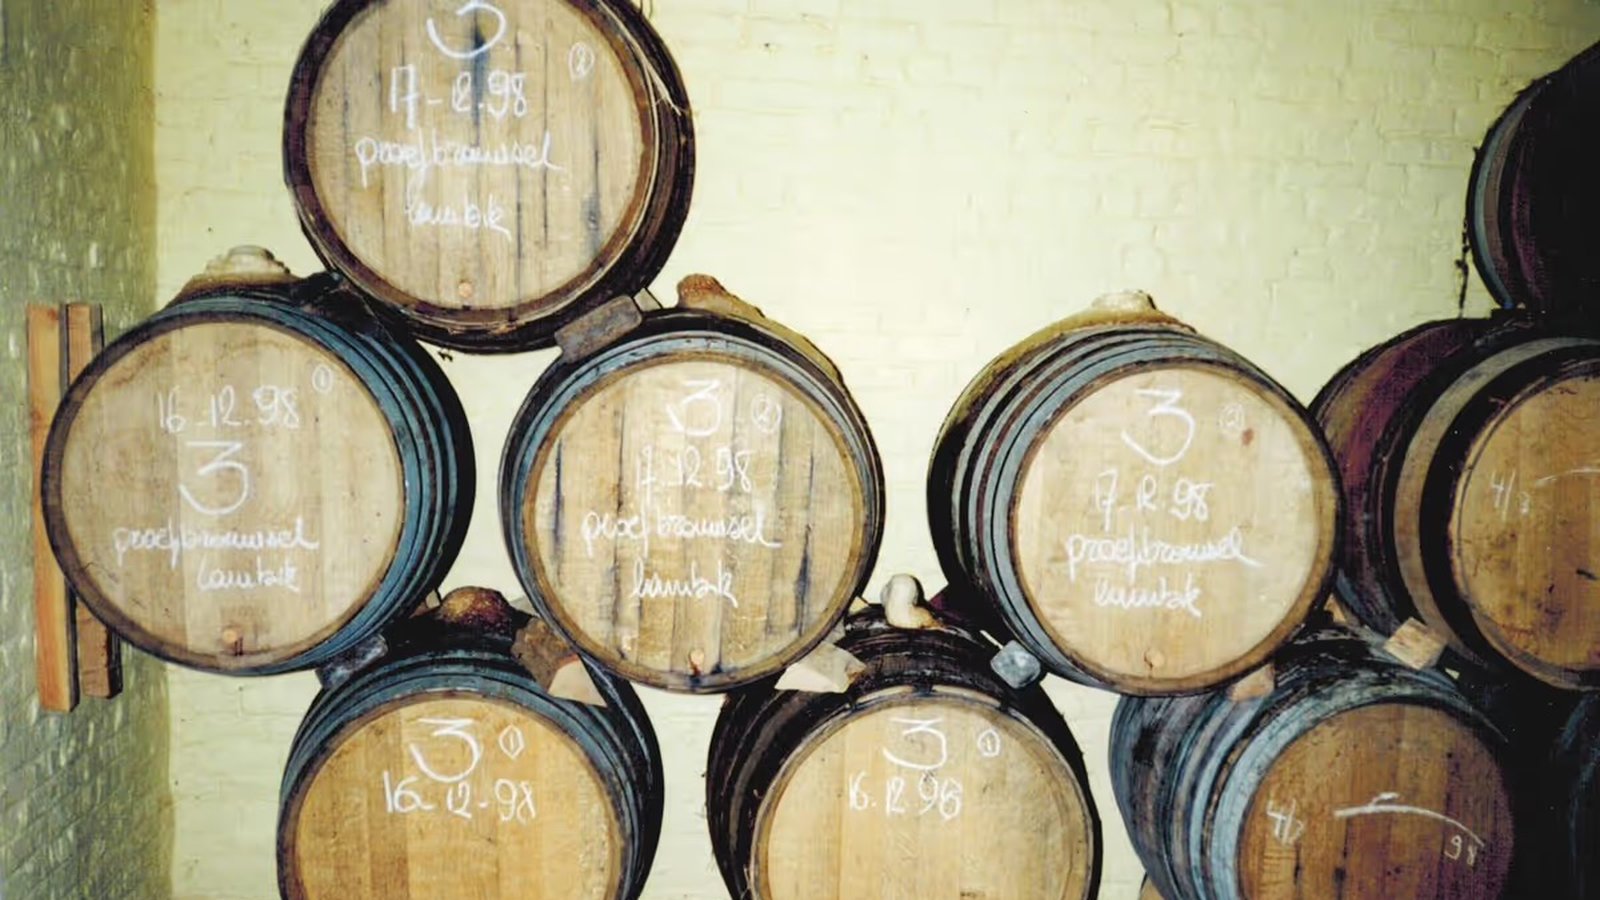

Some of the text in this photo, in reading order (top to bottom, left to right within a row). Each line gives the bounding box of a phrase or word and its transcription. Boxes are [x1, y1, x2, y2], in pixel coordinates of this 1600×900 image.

[426, 2, 507, 59] 3
[666, 379, 724, 437] 3
[1120, 388, 1196, 466] 3
[178, 440, 249, 516] 3
[408, 717, 483, 783] 3
[882, 716, 948, 771] 3
